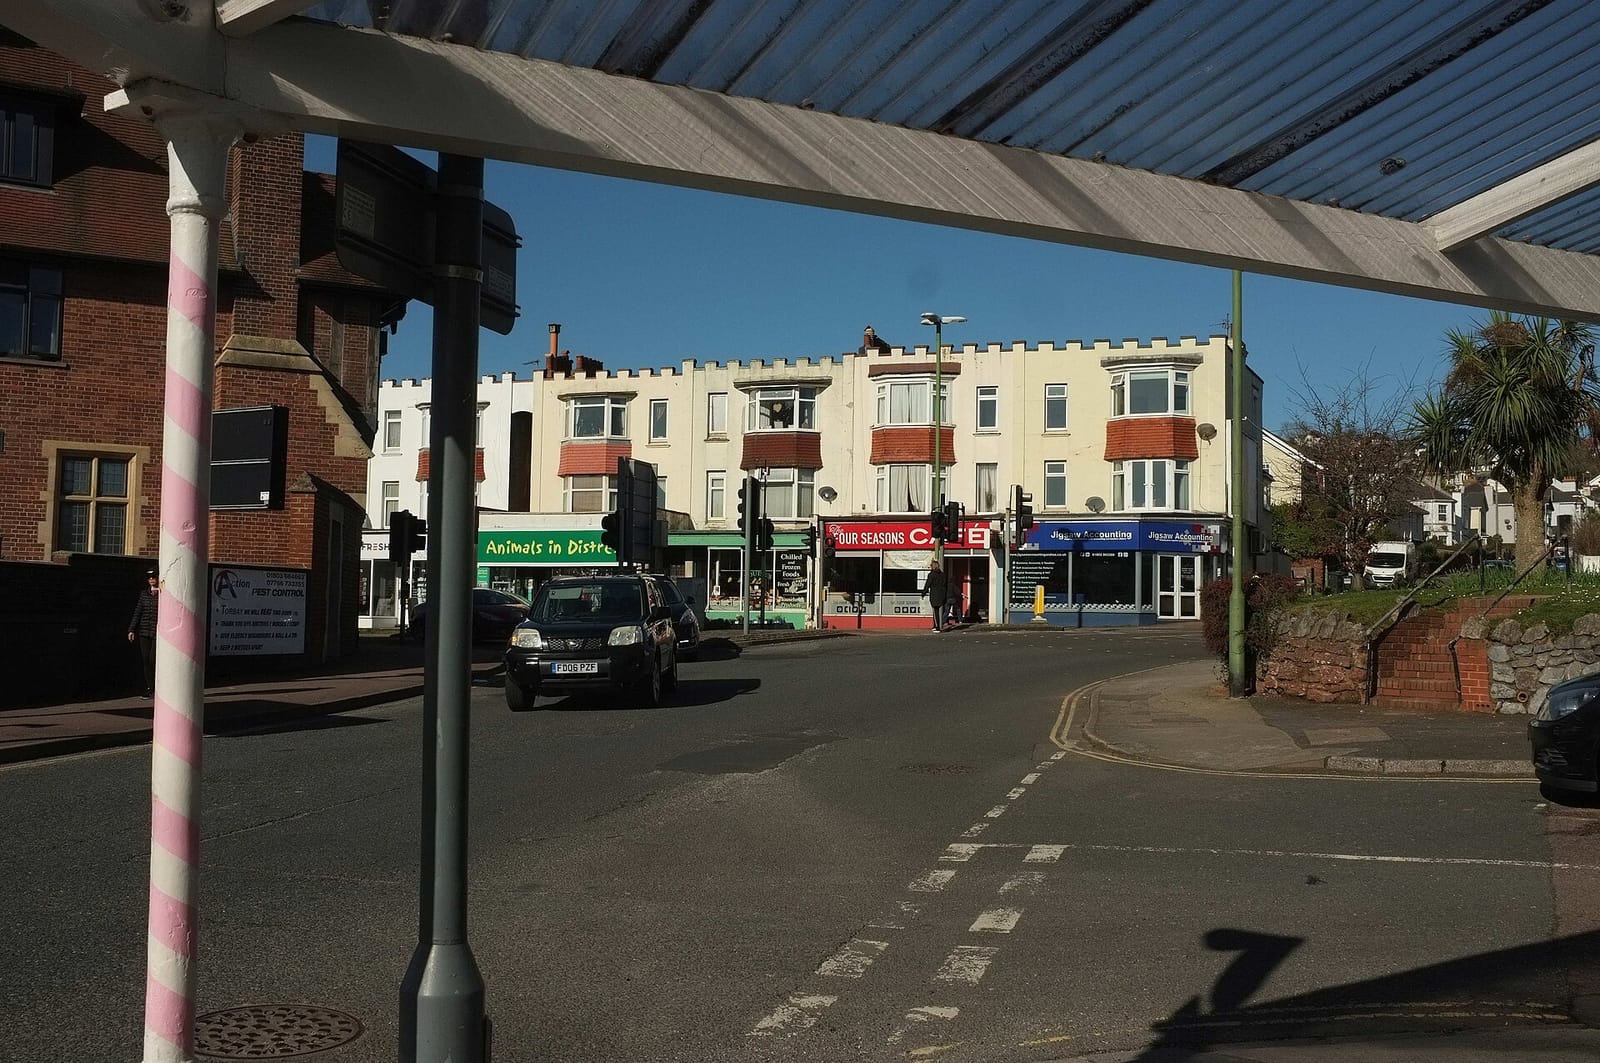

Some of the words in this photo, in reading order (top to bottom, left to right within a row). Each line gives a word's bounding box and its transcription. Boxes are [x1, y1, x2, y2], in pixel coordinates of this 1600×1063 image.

[861, 532, 905, 545] SEASONS
[1050, 530, 1081, 540] Jigsaw
[1083, 530, 1132, 540] Accounting
[1148, 531, 1174, 541] Jigsaw
[1174, 532, 1214, 542] Accounting
[486, 540, 543, 555] Animals
[548, 540, 562, 555] in
[252, 588, 271, 596] PEST
[272, 589, 305, 597] CONTROL
[557, 663, 578, 672] FD06
[580, 663, 596, 672] PZF
